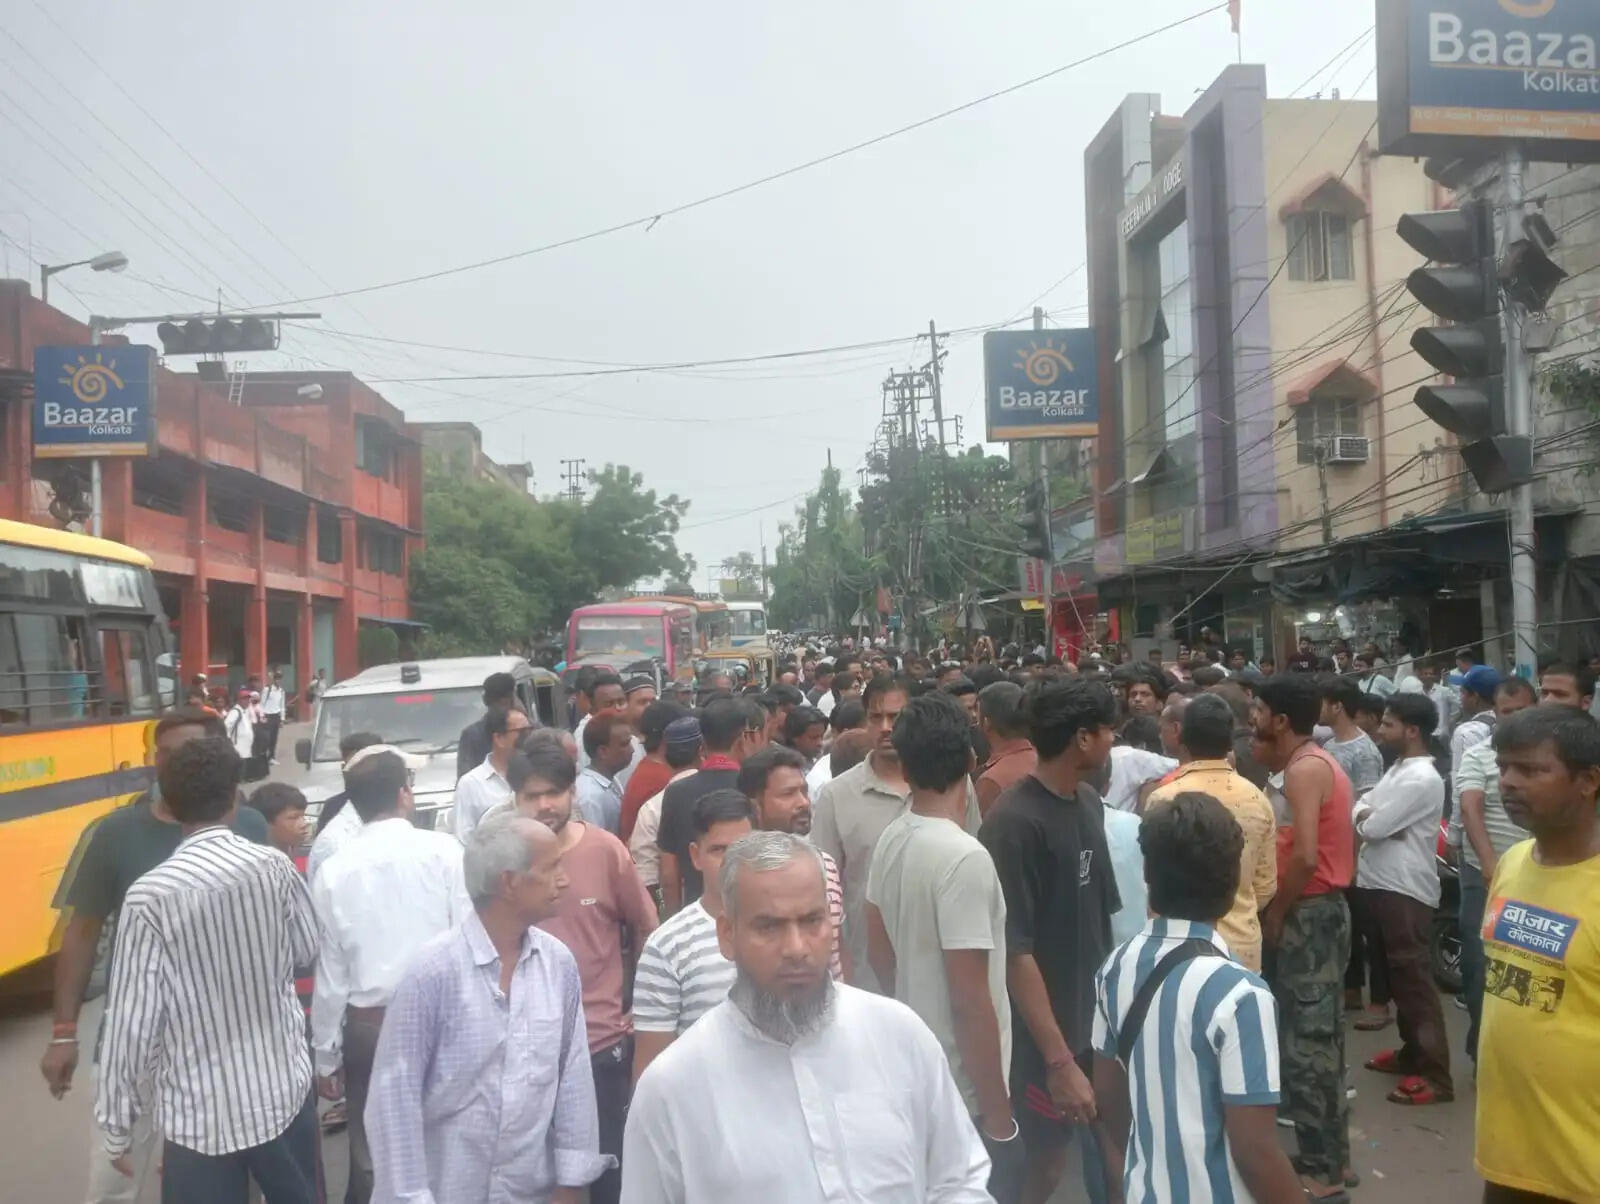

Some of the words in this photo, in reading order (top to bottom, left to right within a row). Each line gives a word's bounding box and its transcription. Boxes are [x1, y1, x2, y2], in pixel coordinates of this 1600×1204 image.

[1429, 12, 1597, 69] Baaza
[1523, 71, 1600, 94] Kolkat
[1000, 386, 1088, 408] Baazar
[44, 401, 138, 425] Baazar
[1042, 407, 1084, 417] Kolkata
[88, 424, 132, 435] Kolkata
[1508, 926, 1562, 952] कोलकाता
